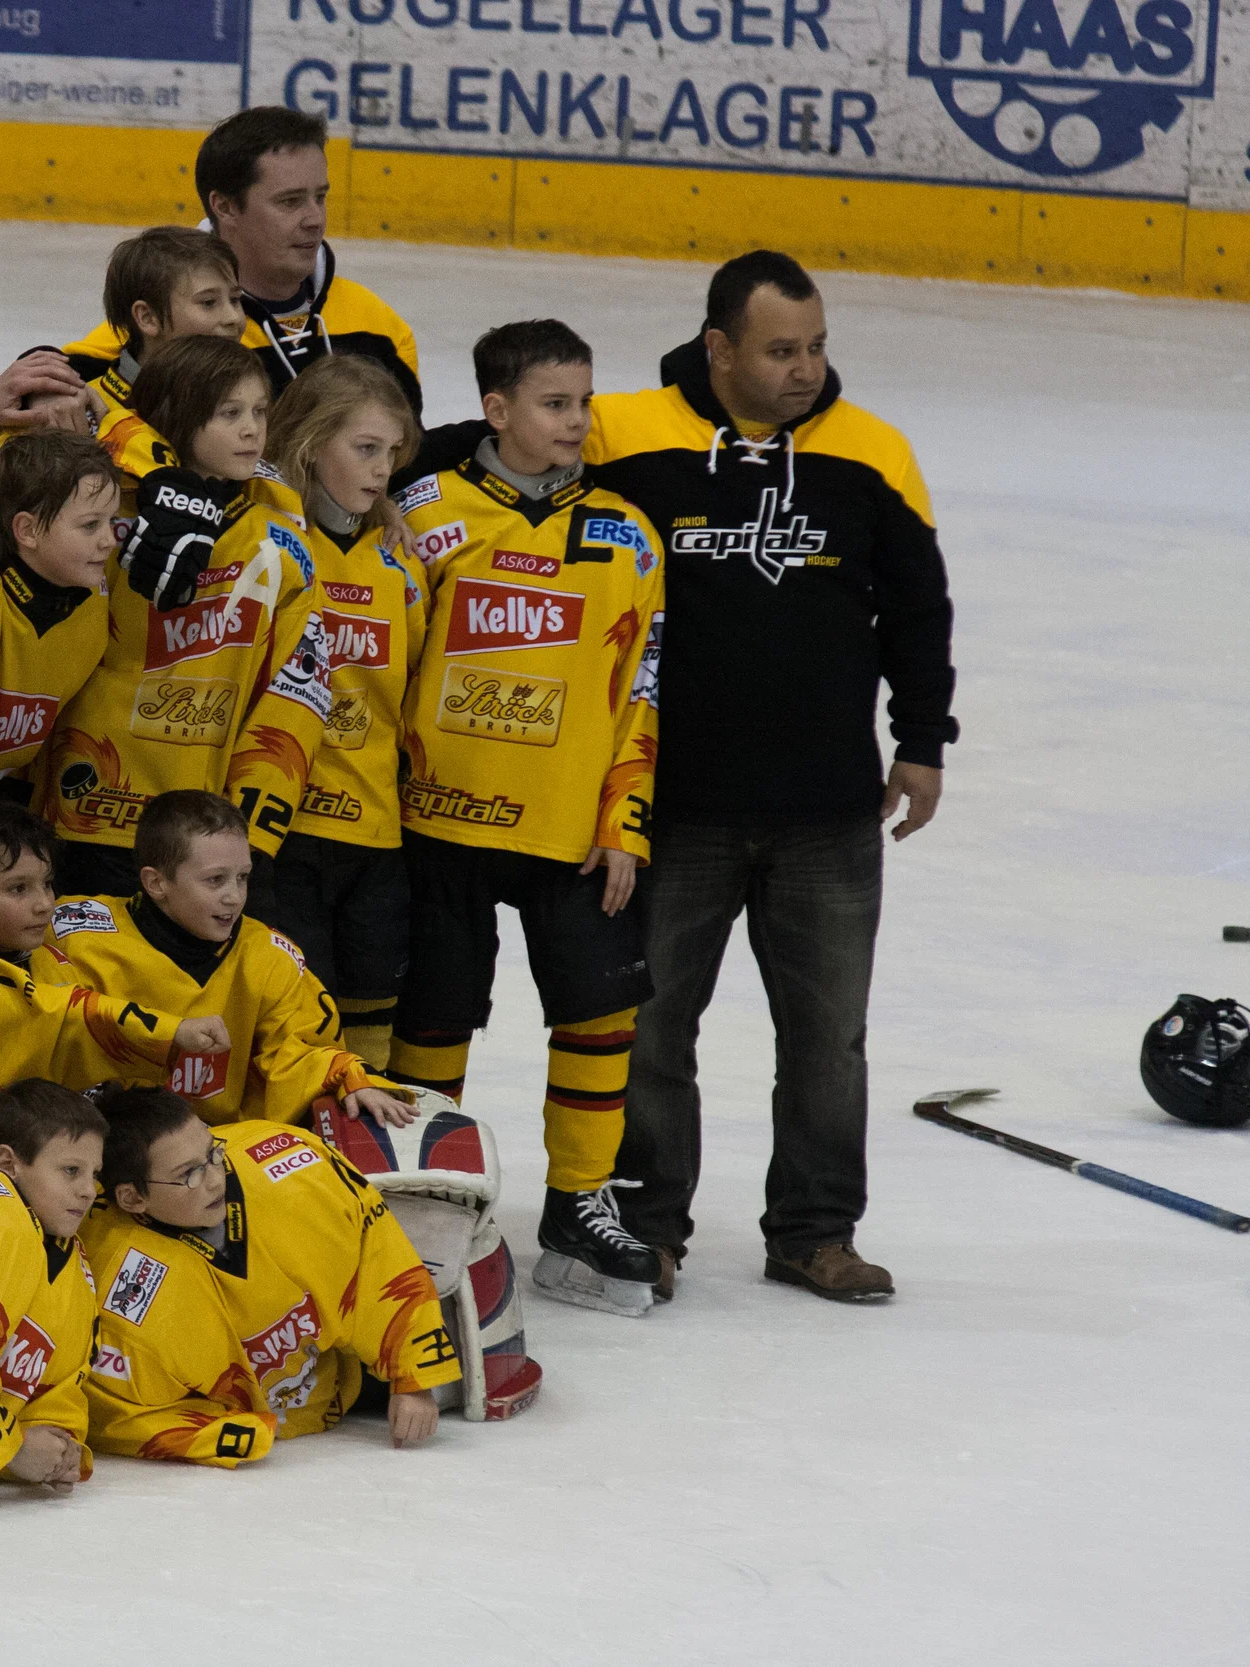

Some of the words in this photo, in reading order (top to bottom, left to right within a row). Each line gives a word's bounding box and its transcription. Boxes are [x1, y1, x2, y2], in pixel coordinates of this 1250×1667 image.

[939, 0, 1193, 76] HAAS
[285, 58, 877, 156] GELENKLAGER
[155, 485, 224, 526] Reebo
[672, 516, 707, 527] JUNIOR
[672, 488, 827, 585] capitals
[197, 569, 224, 586] SKÖ
[496, 554, 537, 571] ASKÖ
[807, 555, 842, 567] HOCKEY
[163, 605, 243, 653] Kellys
[468, 596, 564, 640] Kelly's
[326, 625, 379, 661] elly's
[138, 683, 234, 726] Strck
[445, 674, 555, 725] Ströck
[164, 725, 205, 738] BRT
[469, 718, 528, 736] BROT
[238, 786, 295, 840] 12
[254, 1134, 290, 1160] ASKÖ
[250, 1312, 317, 1372] elly's
